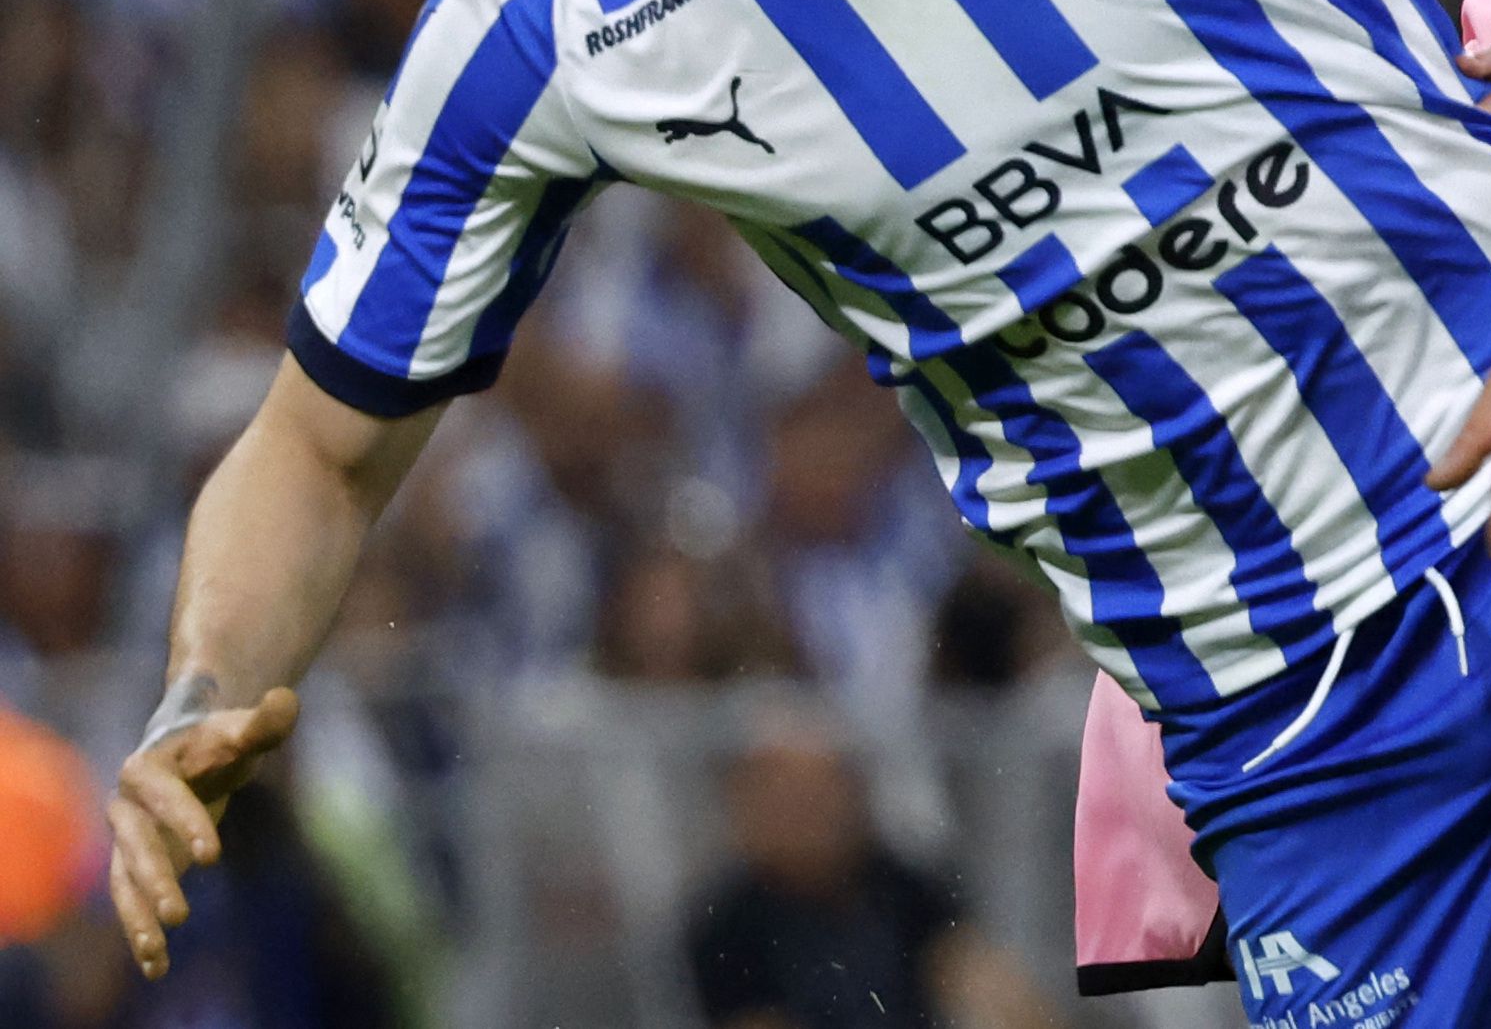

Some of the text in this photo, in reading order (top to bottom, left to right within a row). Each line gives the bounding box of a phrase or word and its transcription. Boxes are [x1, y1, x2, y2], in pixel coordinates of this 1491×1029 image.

[915, 86, 1173, 265] BBVA
[996, 140, 1310, 359] codere
[1308, 967, 1410, 1029] Angeles
